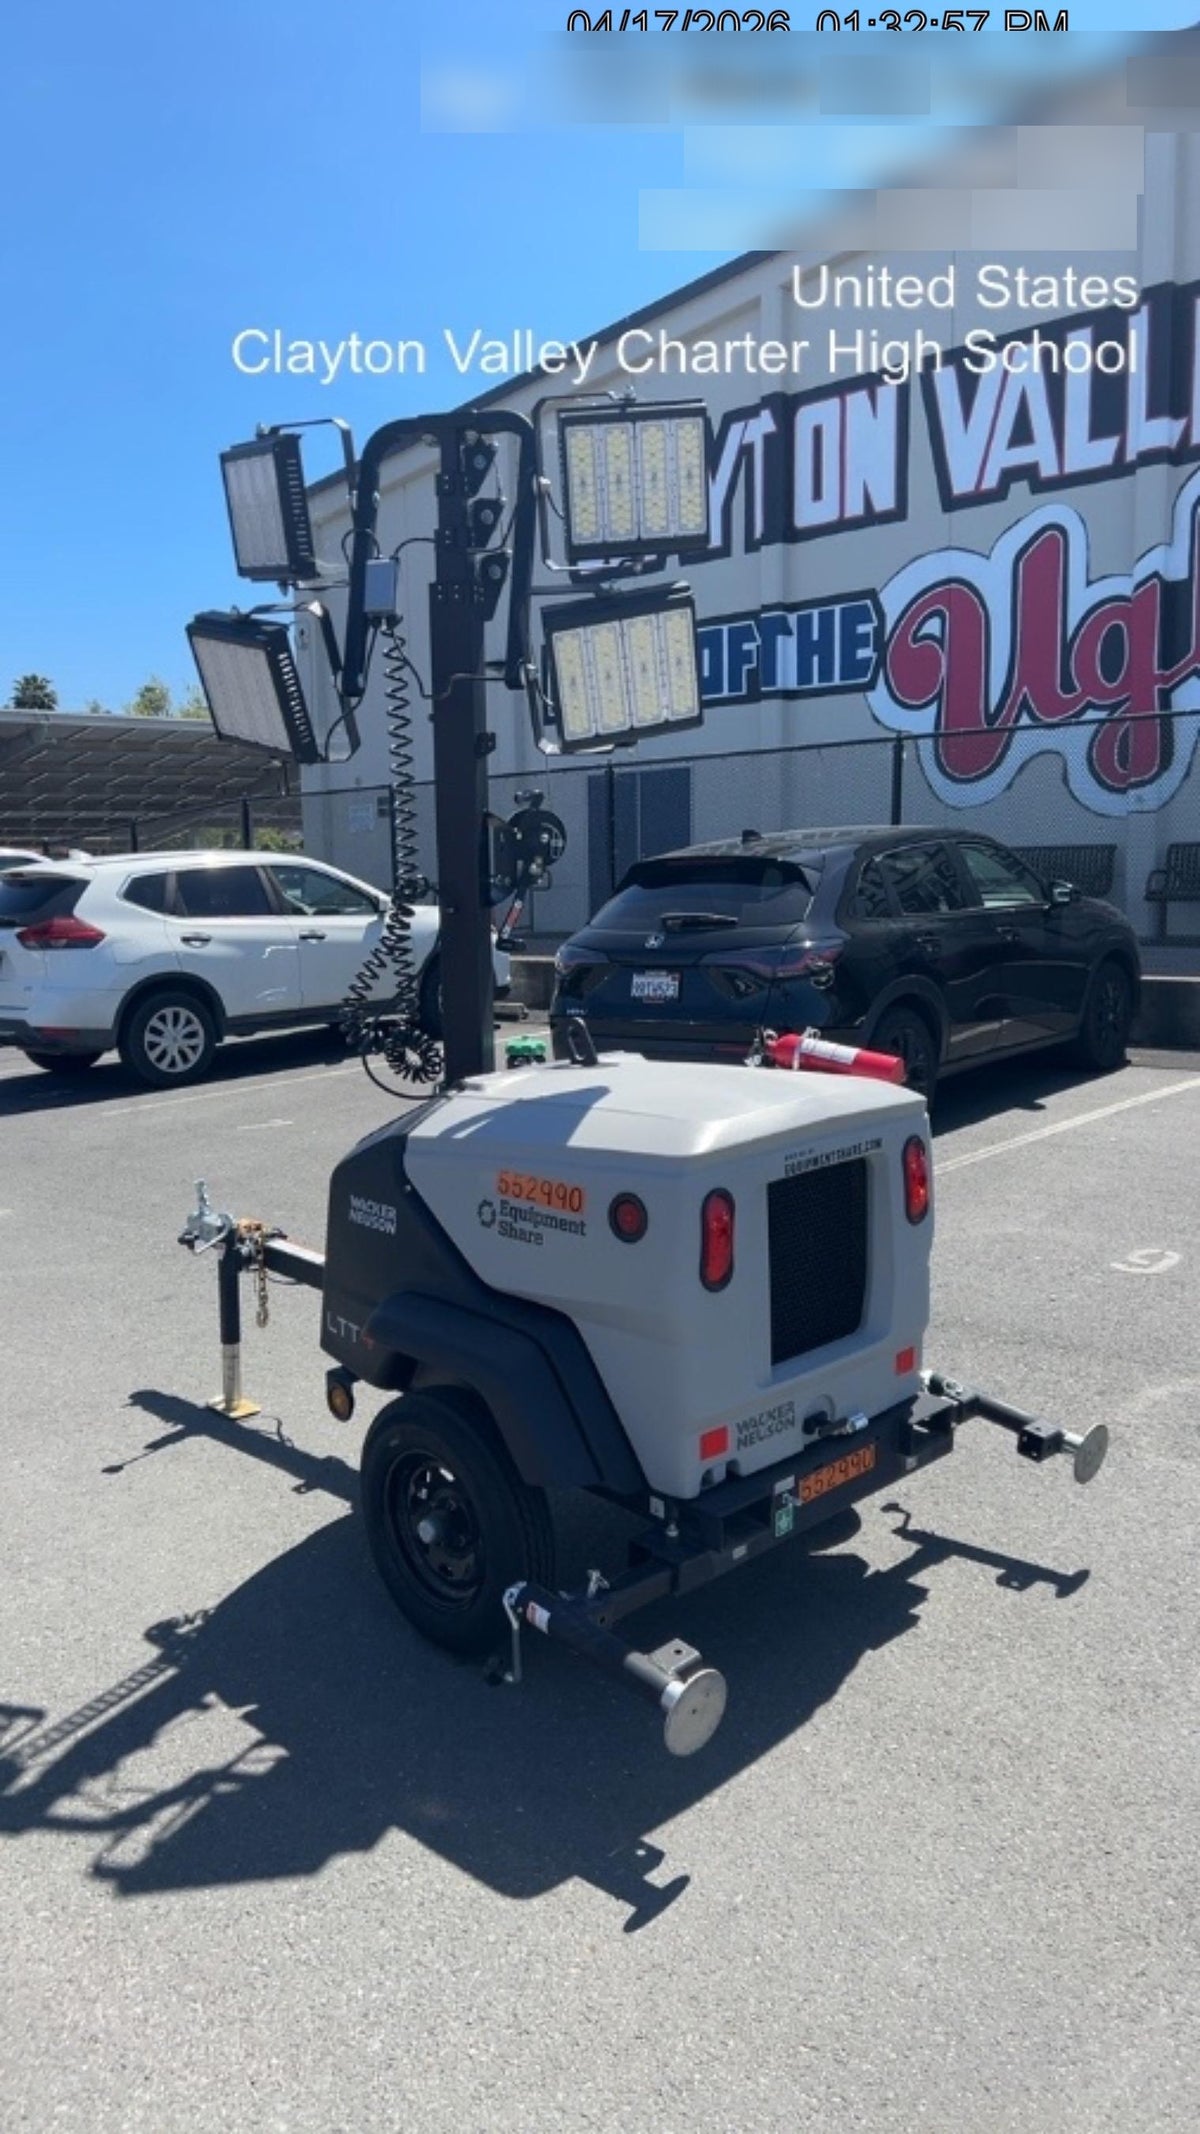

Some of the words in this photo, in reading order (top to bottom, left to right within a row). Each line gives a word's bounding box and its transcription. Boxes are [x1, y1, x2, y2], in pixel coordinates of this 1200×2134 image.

[930, 292, 1200, 498] VALL
[760, 599, 877, 692] THE
[886, 505, 1200, 790] Ug
[497, 1172, 584, 1213] 552990
[497, 1220, 545, 1246] Share
[499, 1199, 587, 1237] Equipment
[735, 1400, 796, 1435] WACKER
